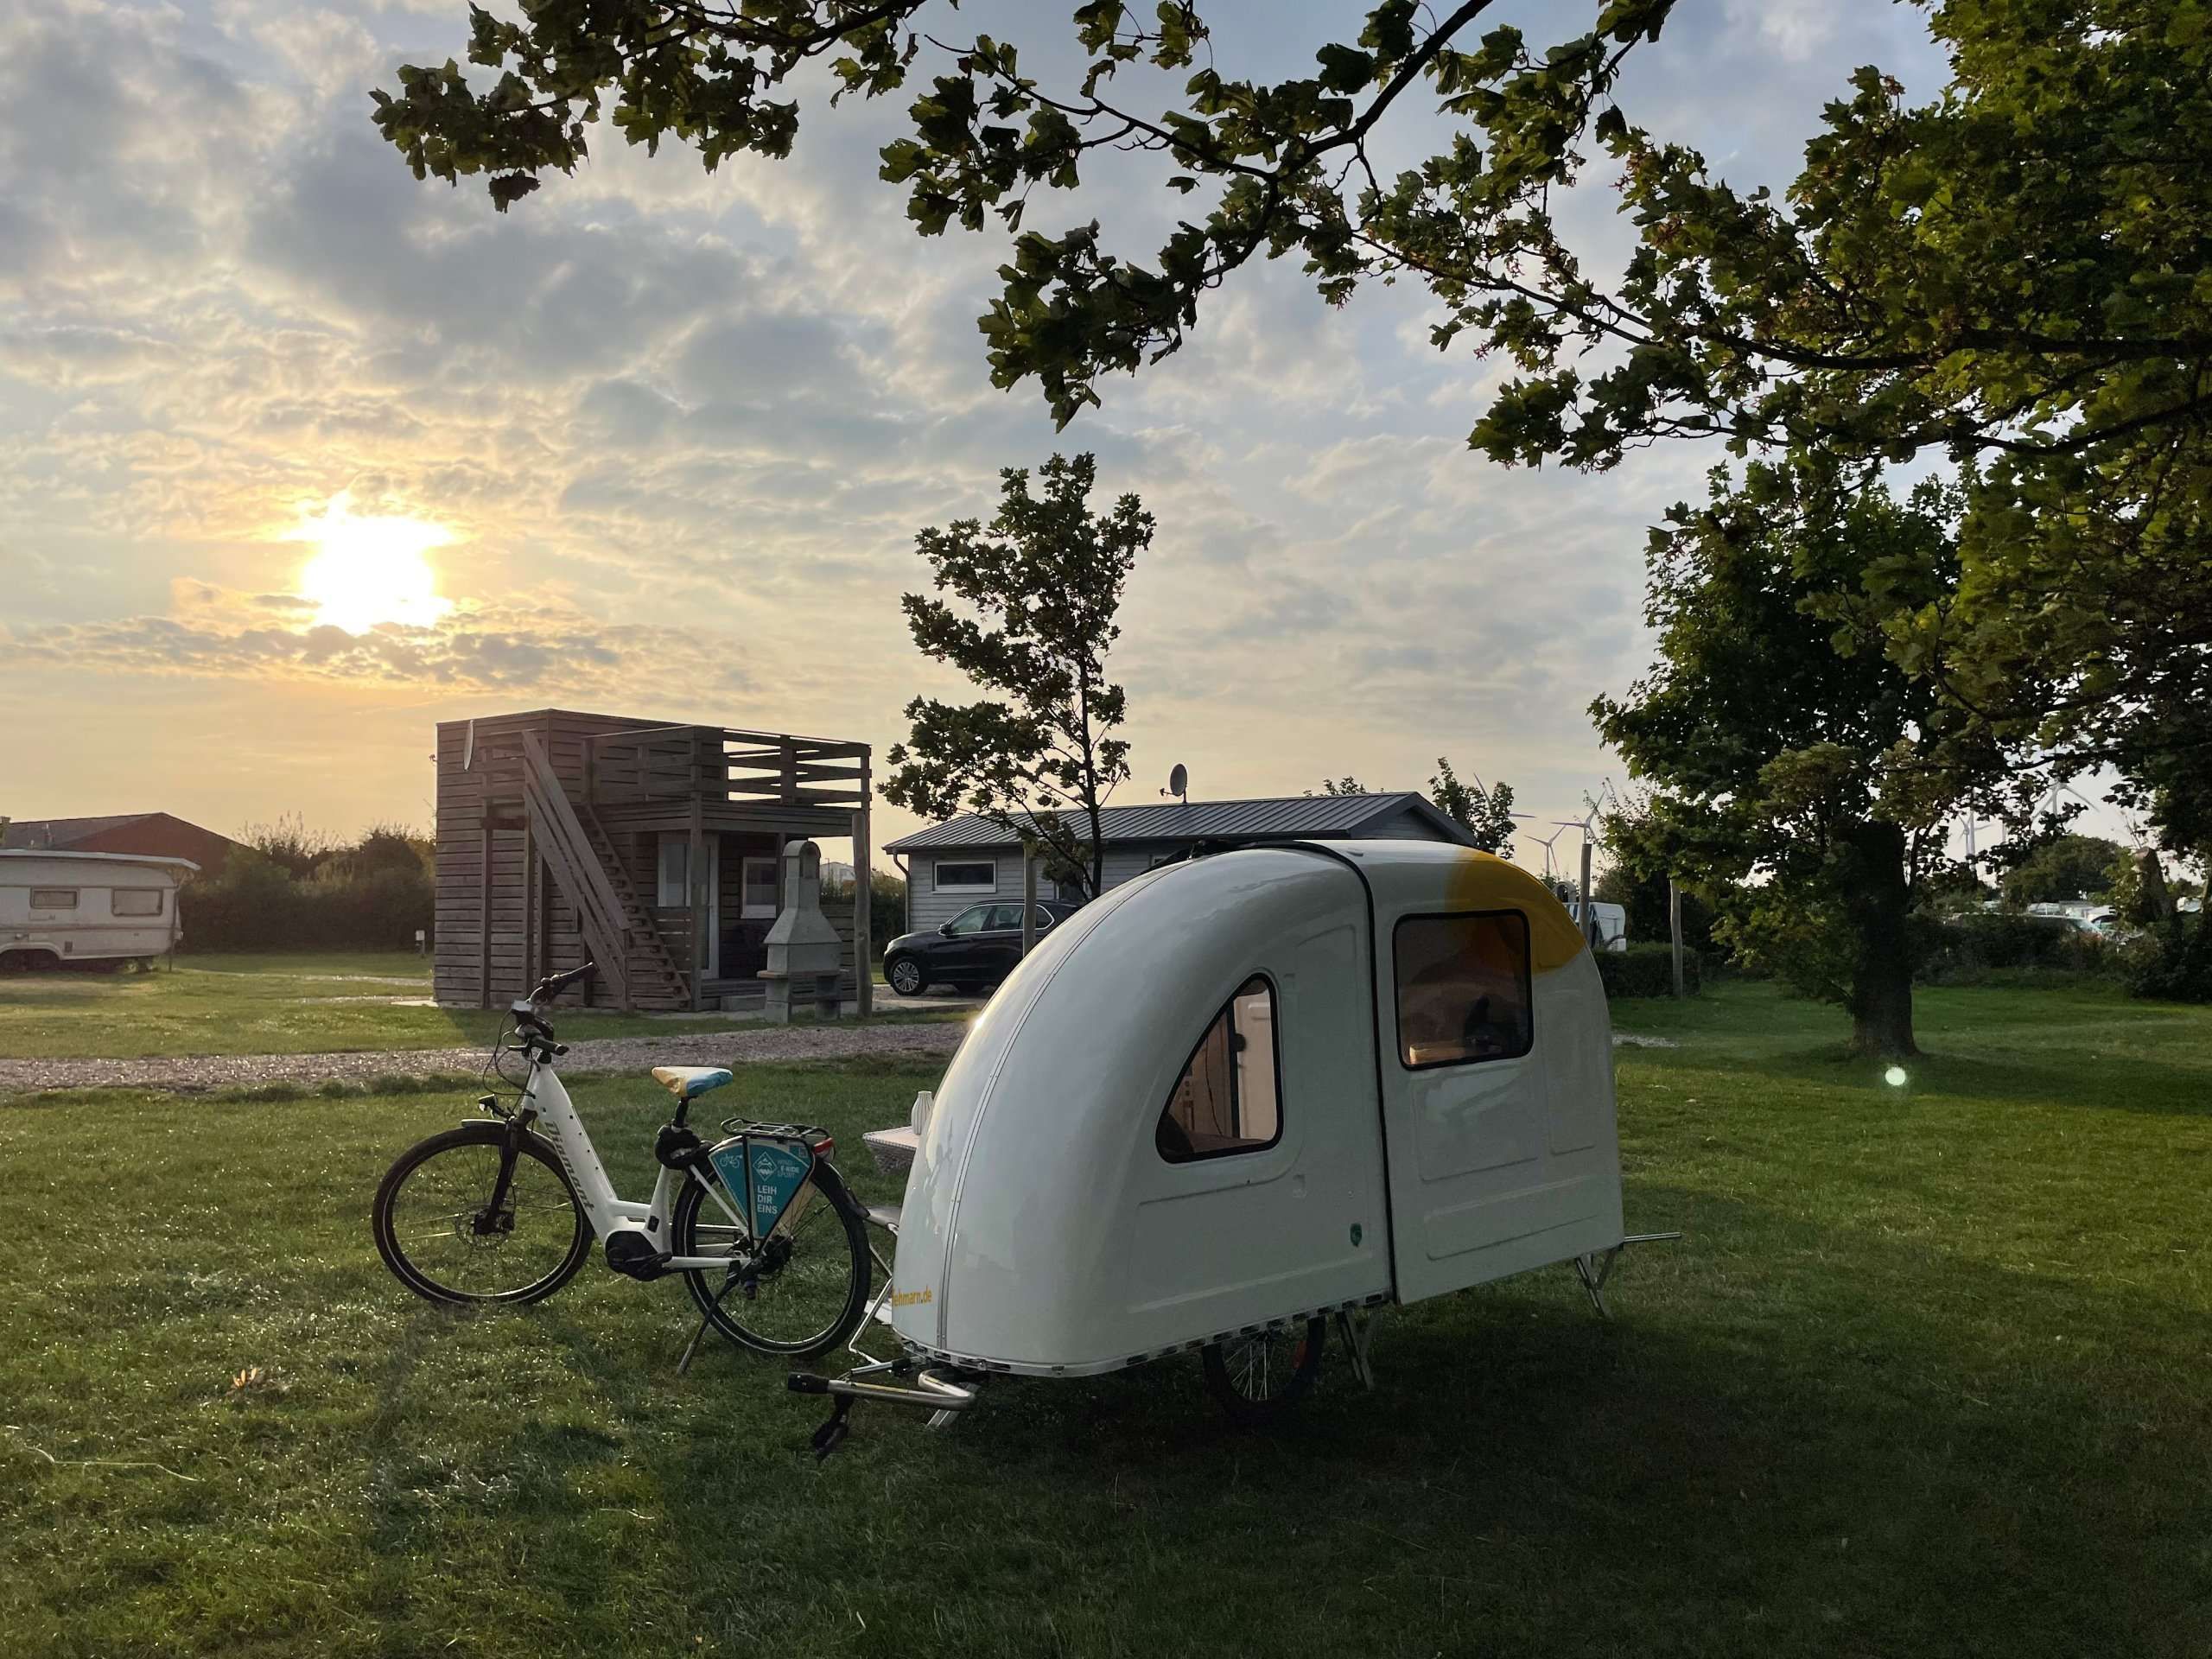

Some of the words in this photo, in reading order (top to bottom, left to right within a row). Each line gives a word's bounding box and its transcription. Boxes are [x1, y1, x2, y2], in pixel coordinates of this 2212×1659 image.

[544, 1121, 595, 1211] Diamant
[757, 1185, 777, 1195] LEIH
[757, 1194, 772, 1204] DIR
[757, 1204, 778, 1214] EINS
